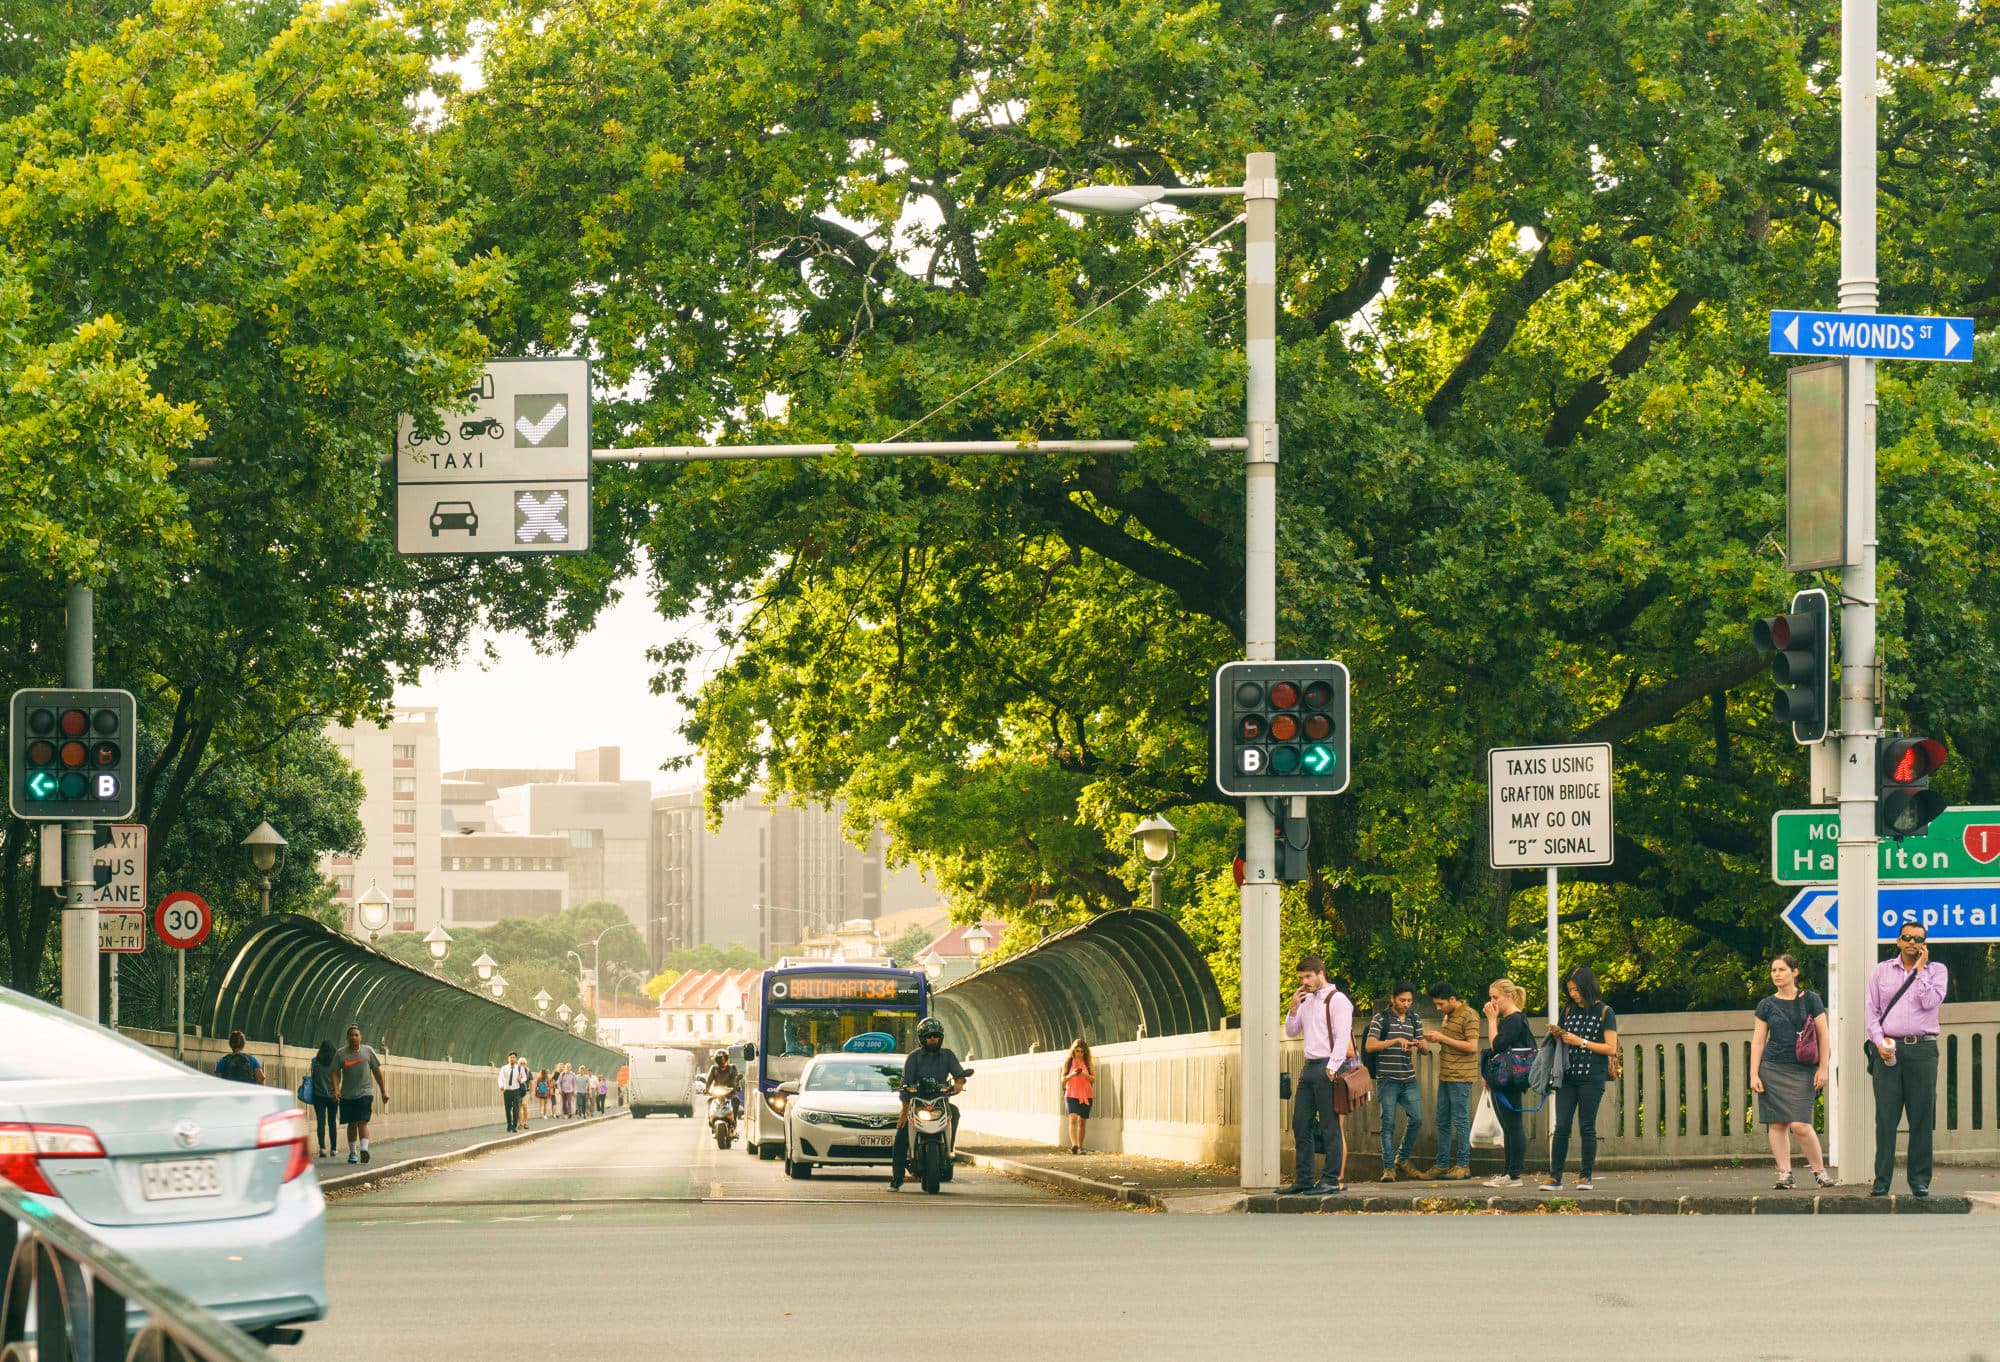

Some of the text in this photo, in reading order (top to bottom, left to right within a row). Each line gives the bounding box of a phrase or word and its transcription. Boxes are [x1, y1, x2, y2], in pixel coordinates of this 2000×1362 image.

[1812, 320, 1933, 350] SYMONDS ST
[430, 452, 483, 469] TAXI
[1244, 750, 1260, 771] B
[1506, 757, 1594, 775] TAXIS USING
[1849, 753, 1858, 765] 4
[98, 775, 114, 797] B
[1500, 783, 1601, 802] GRAFTON BRIDGE
[1511, 810, 1591, 829] MAY GO ON
[1544, 837, 1596, 855] SIGNAL
[1980, 831, 1988, 853] 1
[1793, 848, 1949, 871] Halton
[1258, 869, 1265, 879] 3
[76, 892, 83, 902] 2
[93, 885, 141, 902] ANE
[169, 910, 198, 930] 30
[1882, 904, 1997, 930] ospital
[99, 935, 139, 947] ON-FRI
[790, 979, 896, 999] BRITOMART 334
